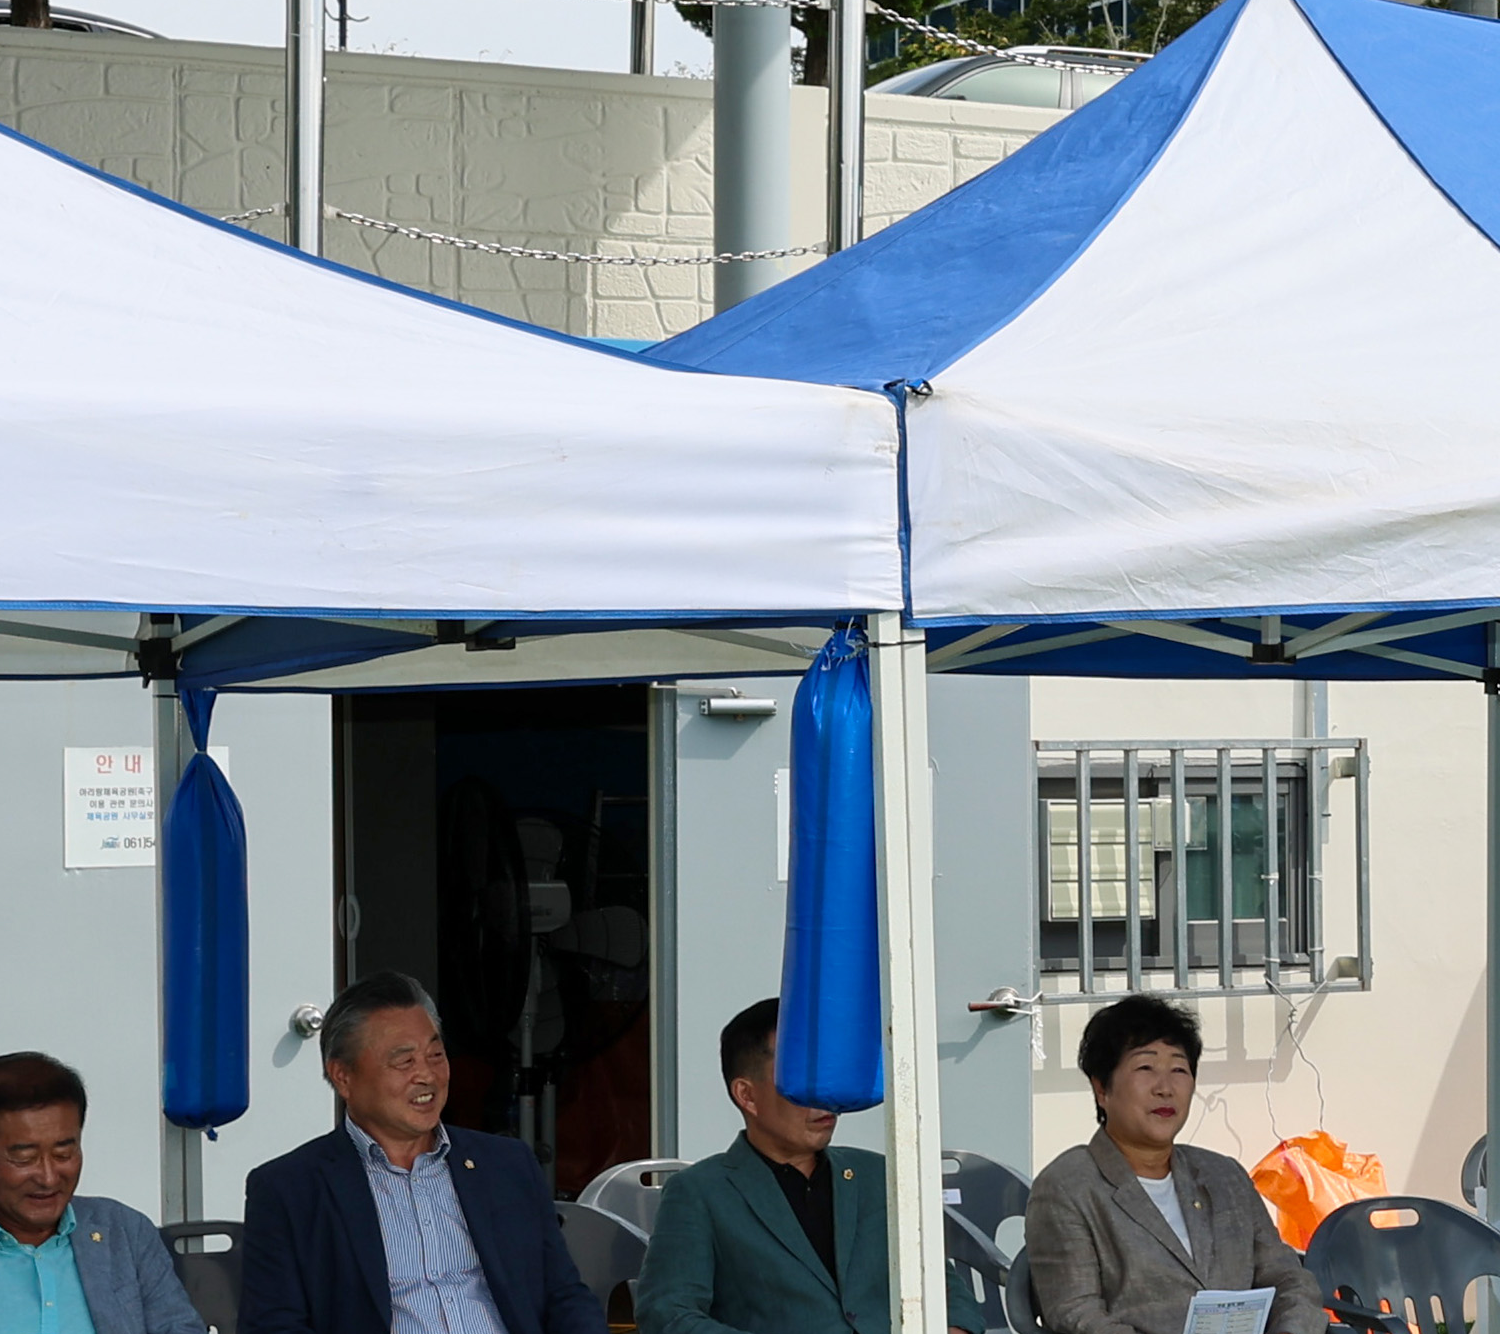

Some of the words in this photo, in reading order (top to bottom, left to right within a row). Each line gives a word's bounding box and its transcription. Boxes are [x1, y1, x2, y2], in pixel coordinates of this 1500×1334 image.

[96, 755, 113, 774] 안
[124, 754, 141, 774] 내
[89, 800, 105, 809] 이용
